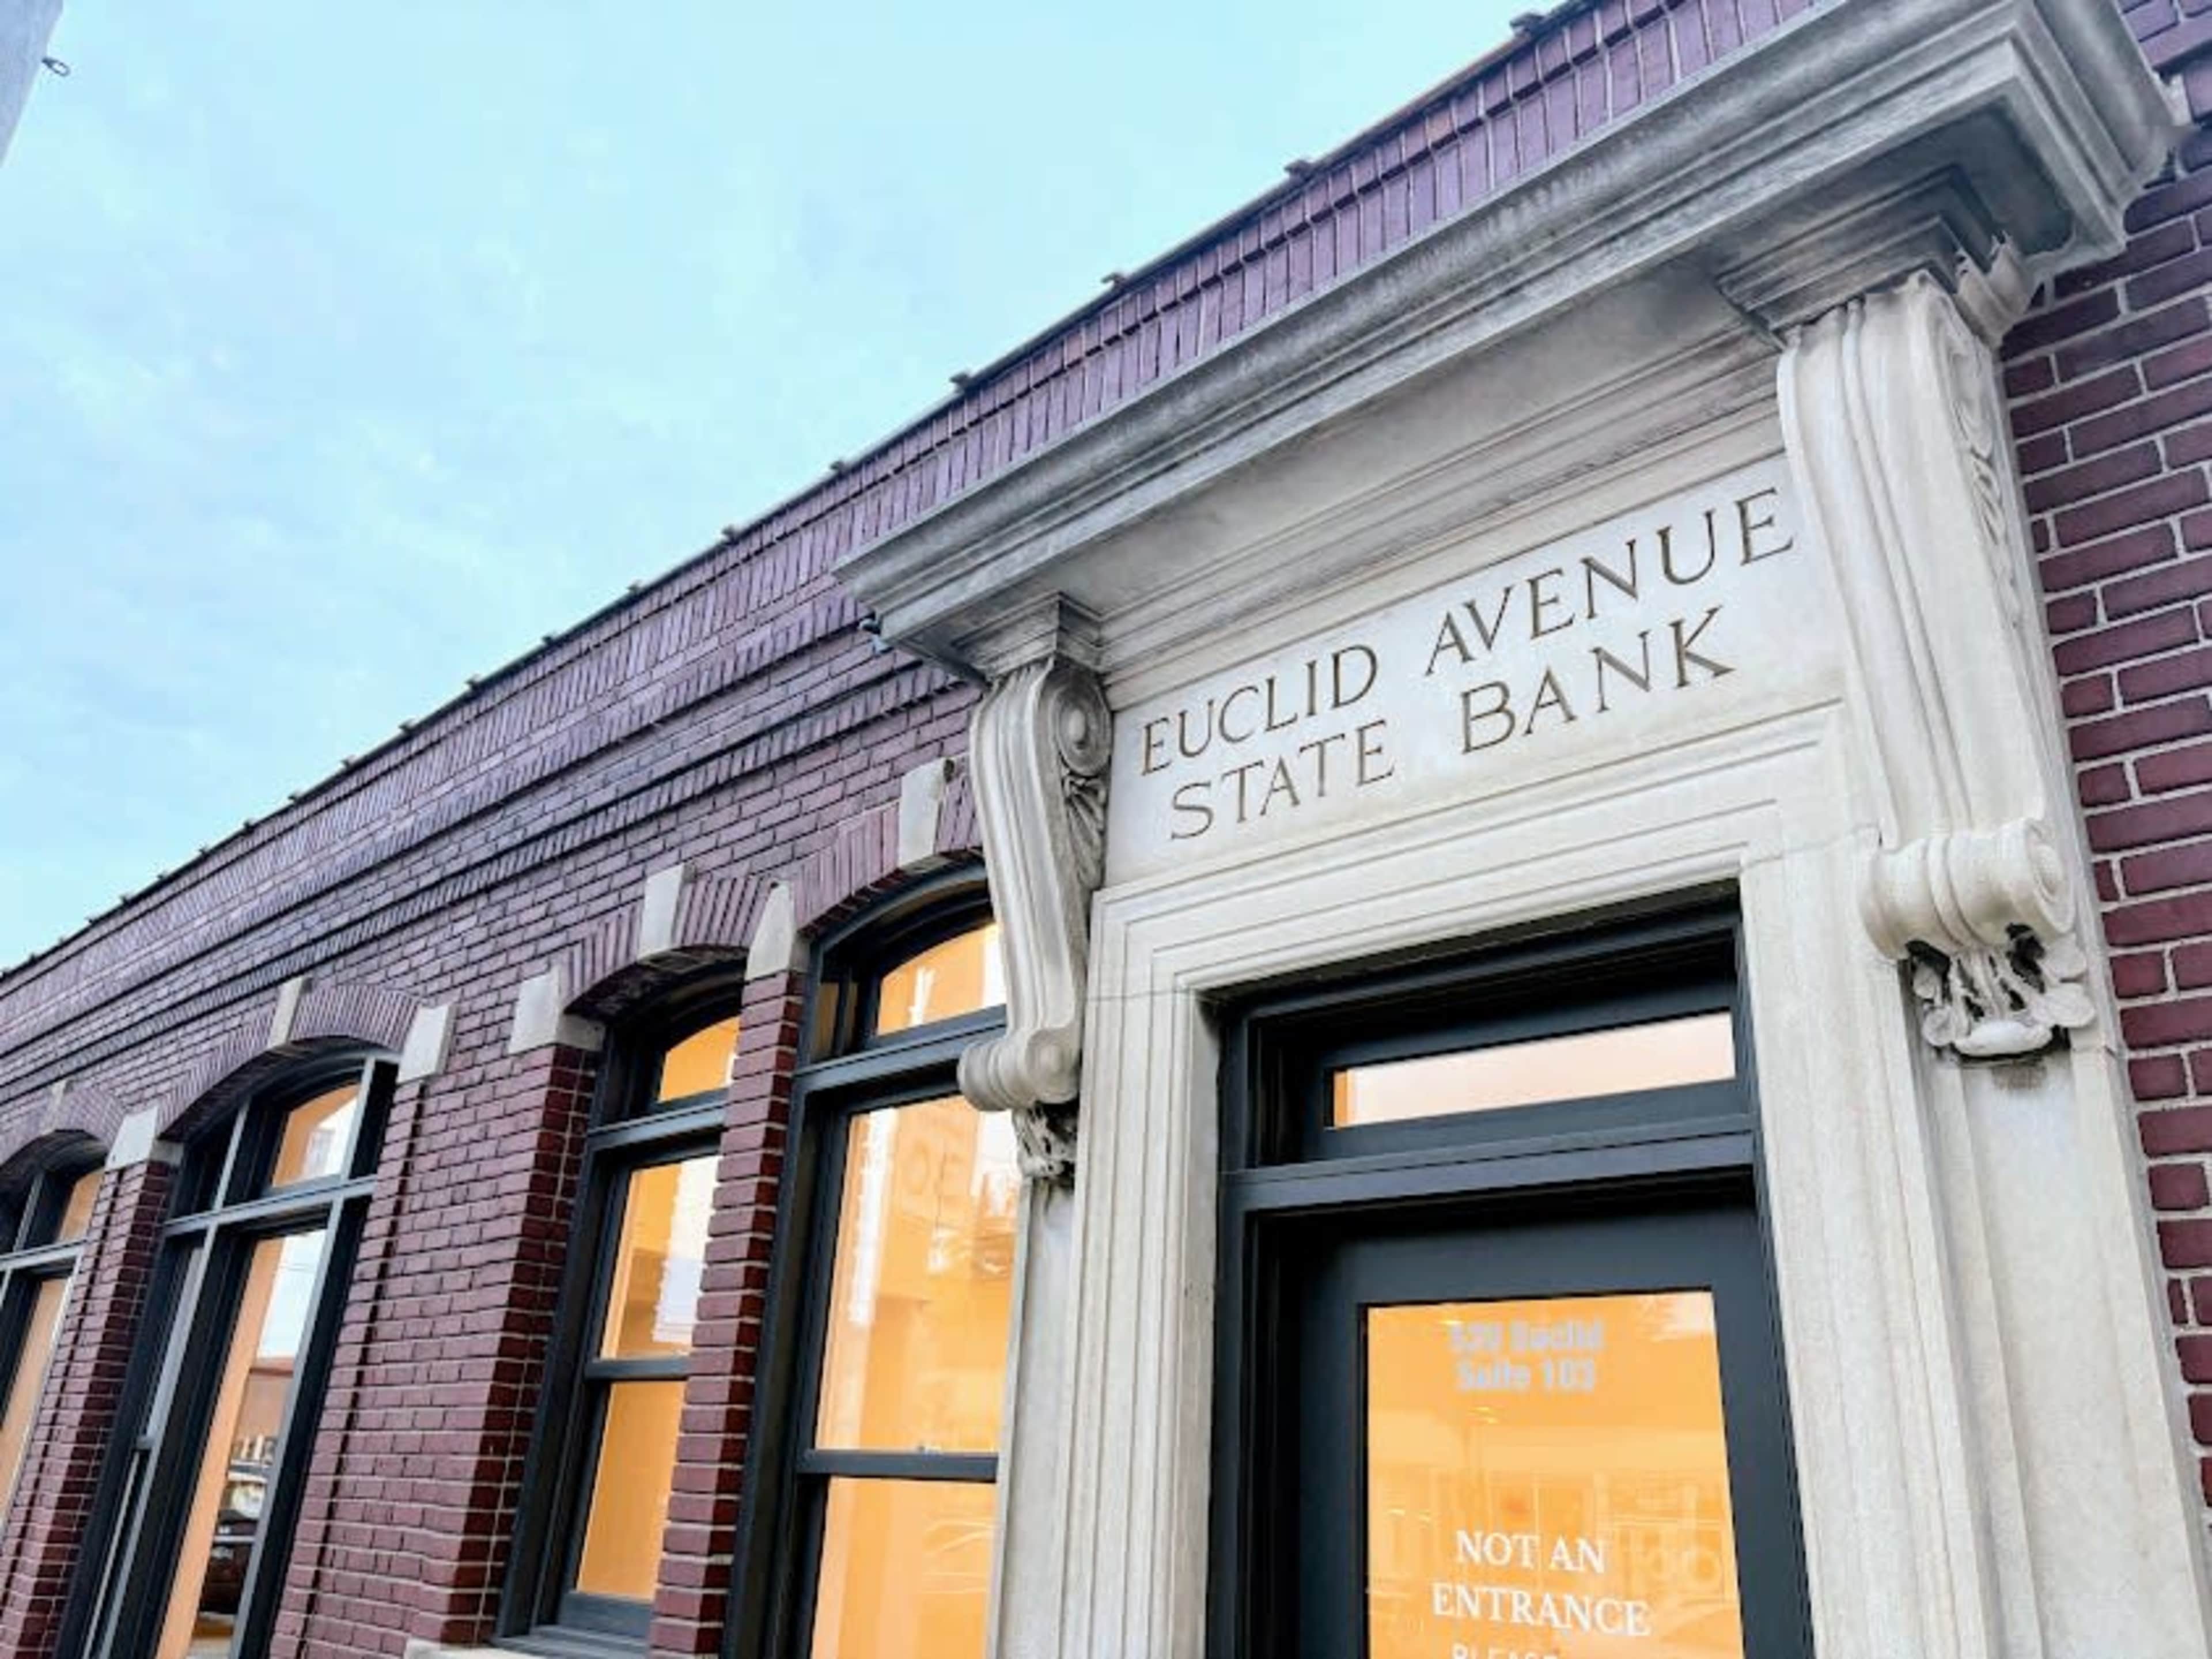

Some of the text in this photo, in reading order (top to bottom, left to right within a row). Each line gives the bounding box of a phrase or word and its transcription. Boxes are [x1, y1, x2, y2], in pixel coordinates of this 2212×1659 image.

[1139, 486, 1795, 777] EUCLID AVENUE
[1170, 604, 1737, 840] STATE BANK
[1431, 1582, 1652, 1638] ENTRANCE
[1456, 1529, 1606, 1574] NOT AN
